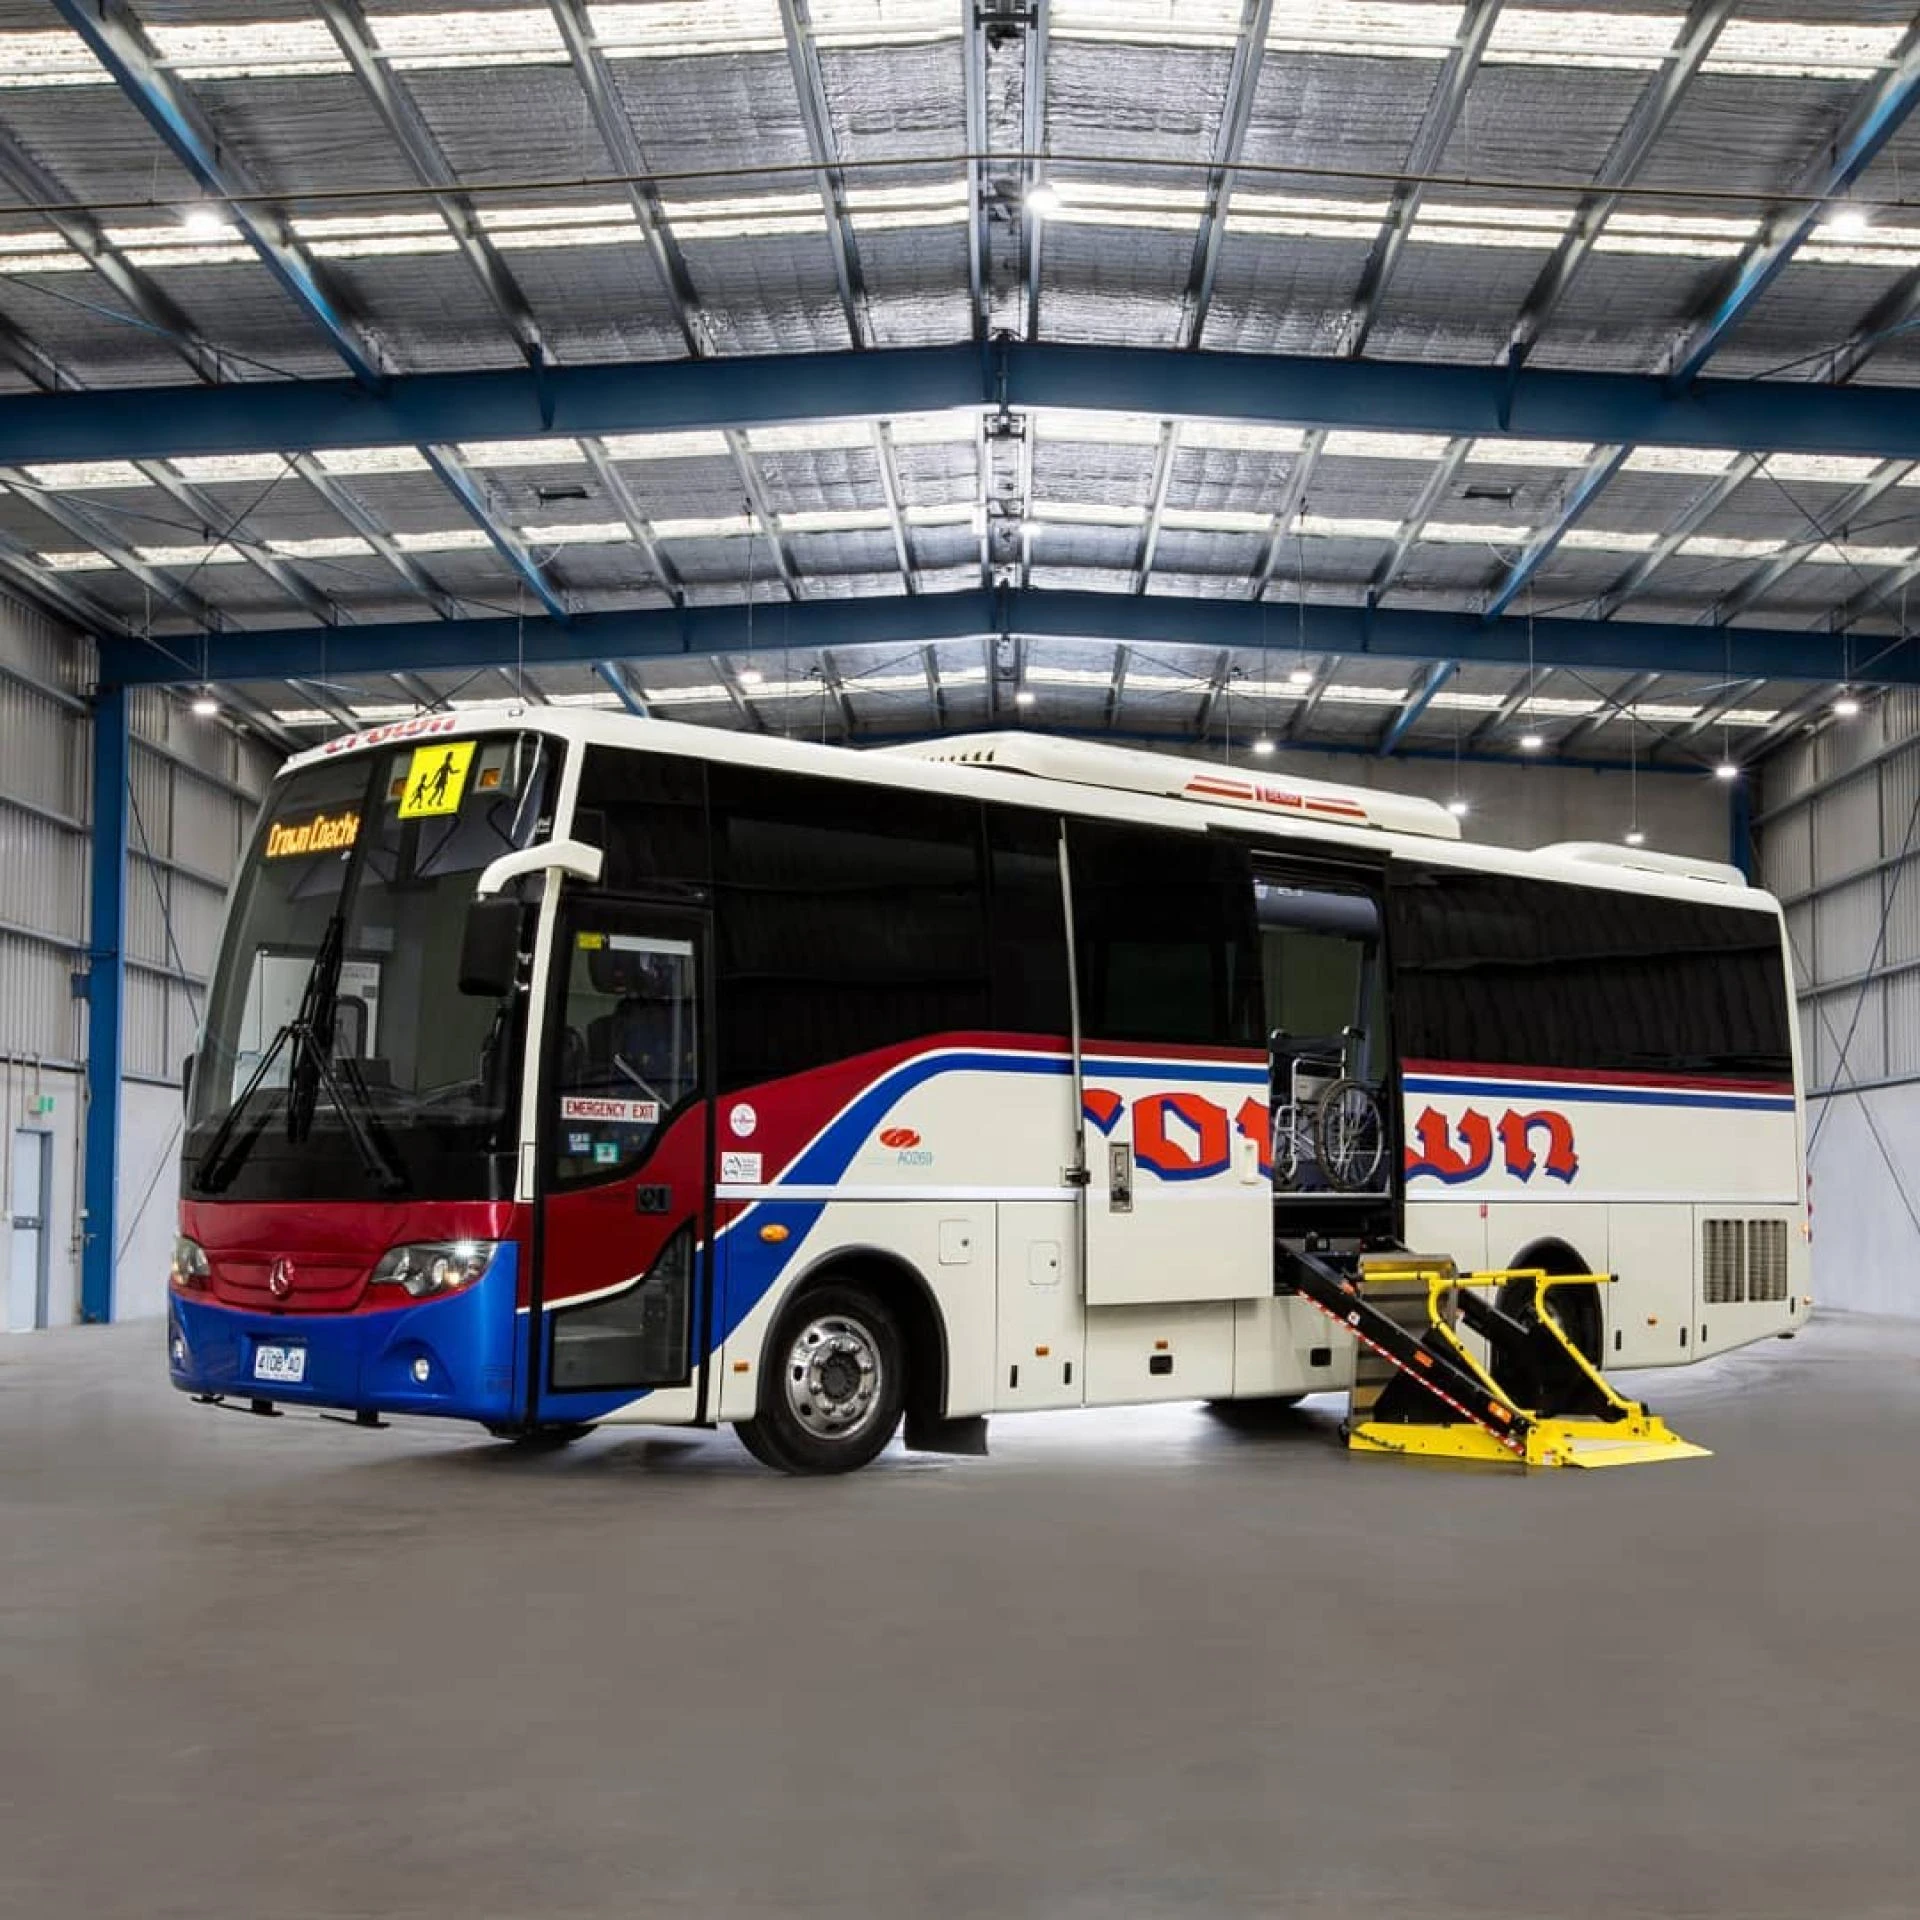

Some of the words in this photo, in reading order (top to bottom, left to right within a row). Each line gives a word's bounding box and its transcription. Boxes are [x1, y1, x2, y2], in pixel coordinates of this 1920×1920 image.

[265, 824, 310, 856] Crown
[566, 1100, 626, 1117] EMERGENCY
[632, 1103, 655, 1121] EXIT
